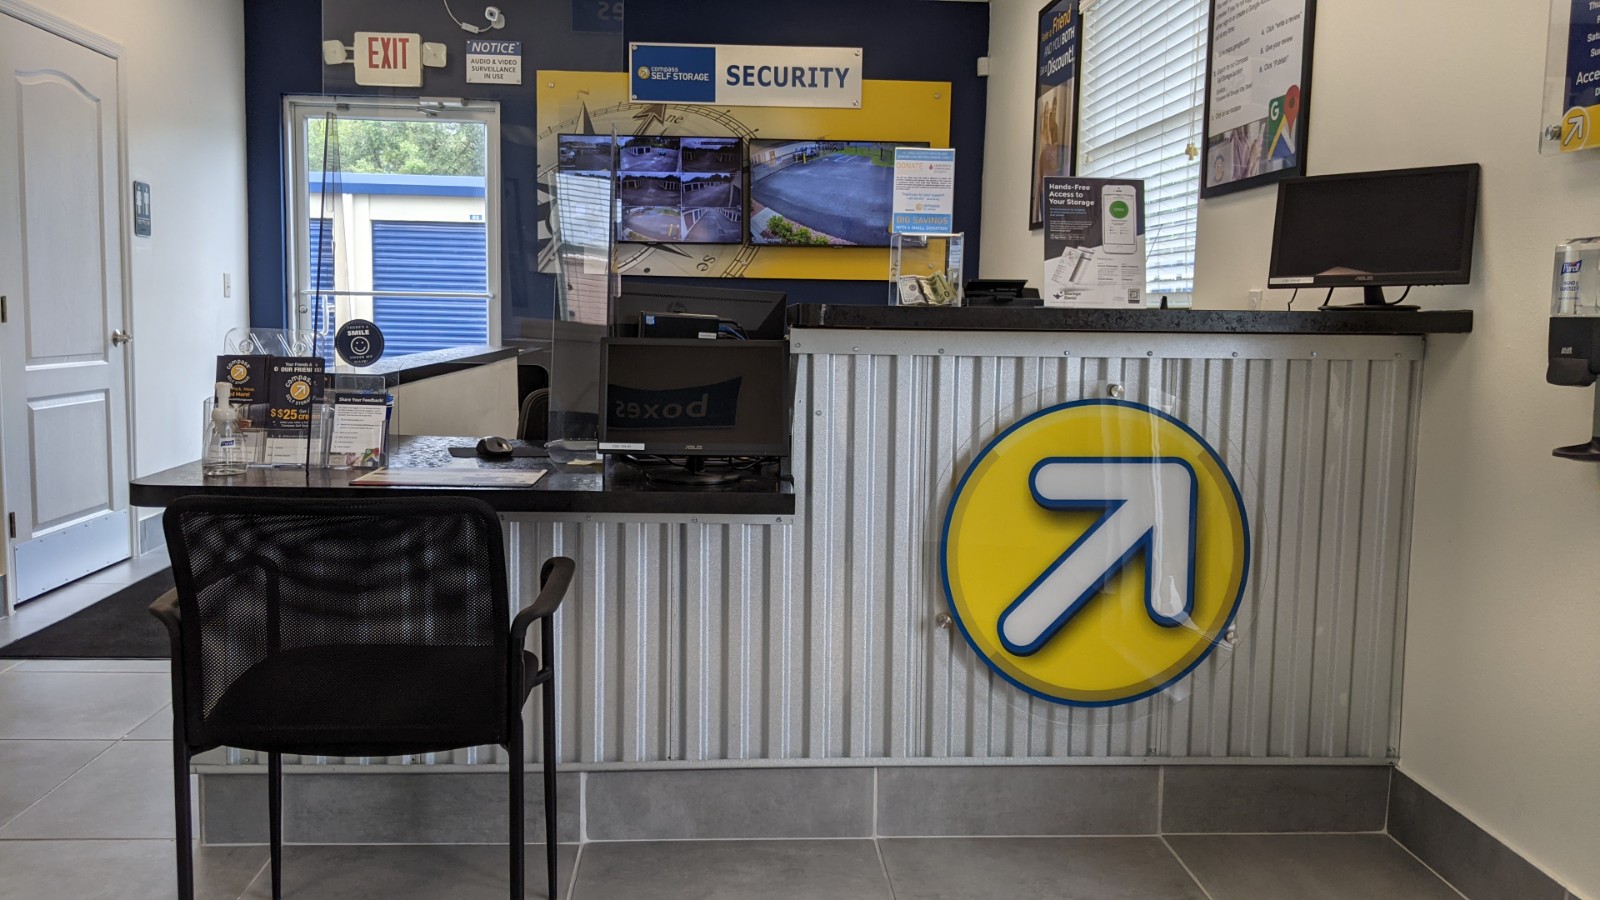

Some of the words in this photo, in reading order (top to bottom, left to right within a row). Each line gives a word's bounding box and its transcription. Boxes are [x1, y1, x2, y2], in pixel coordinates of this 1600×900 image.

[1053, 3, 1072, 35] Friend
[1062, 26, 1075, 45] BOTH
[368, 37, 409, 69] EXIT
[471, 42, 515, 54] NOTICE
[1047, 44, 1075, 77] Discount!
[471, 65, 517, 73] SURVEILLANCE
[726, 64, 850, 88] SECURITY
[651, 72, 672, 80] SELF
[673, 73, 709, 82] STORAGE
[1270, 101, 1280, 121] G
[1049, 183, 1091, 191] Hands-Free
[1067, 199, 1095, 207] Storage
[913, 216, 948, 224] SAVINGS
